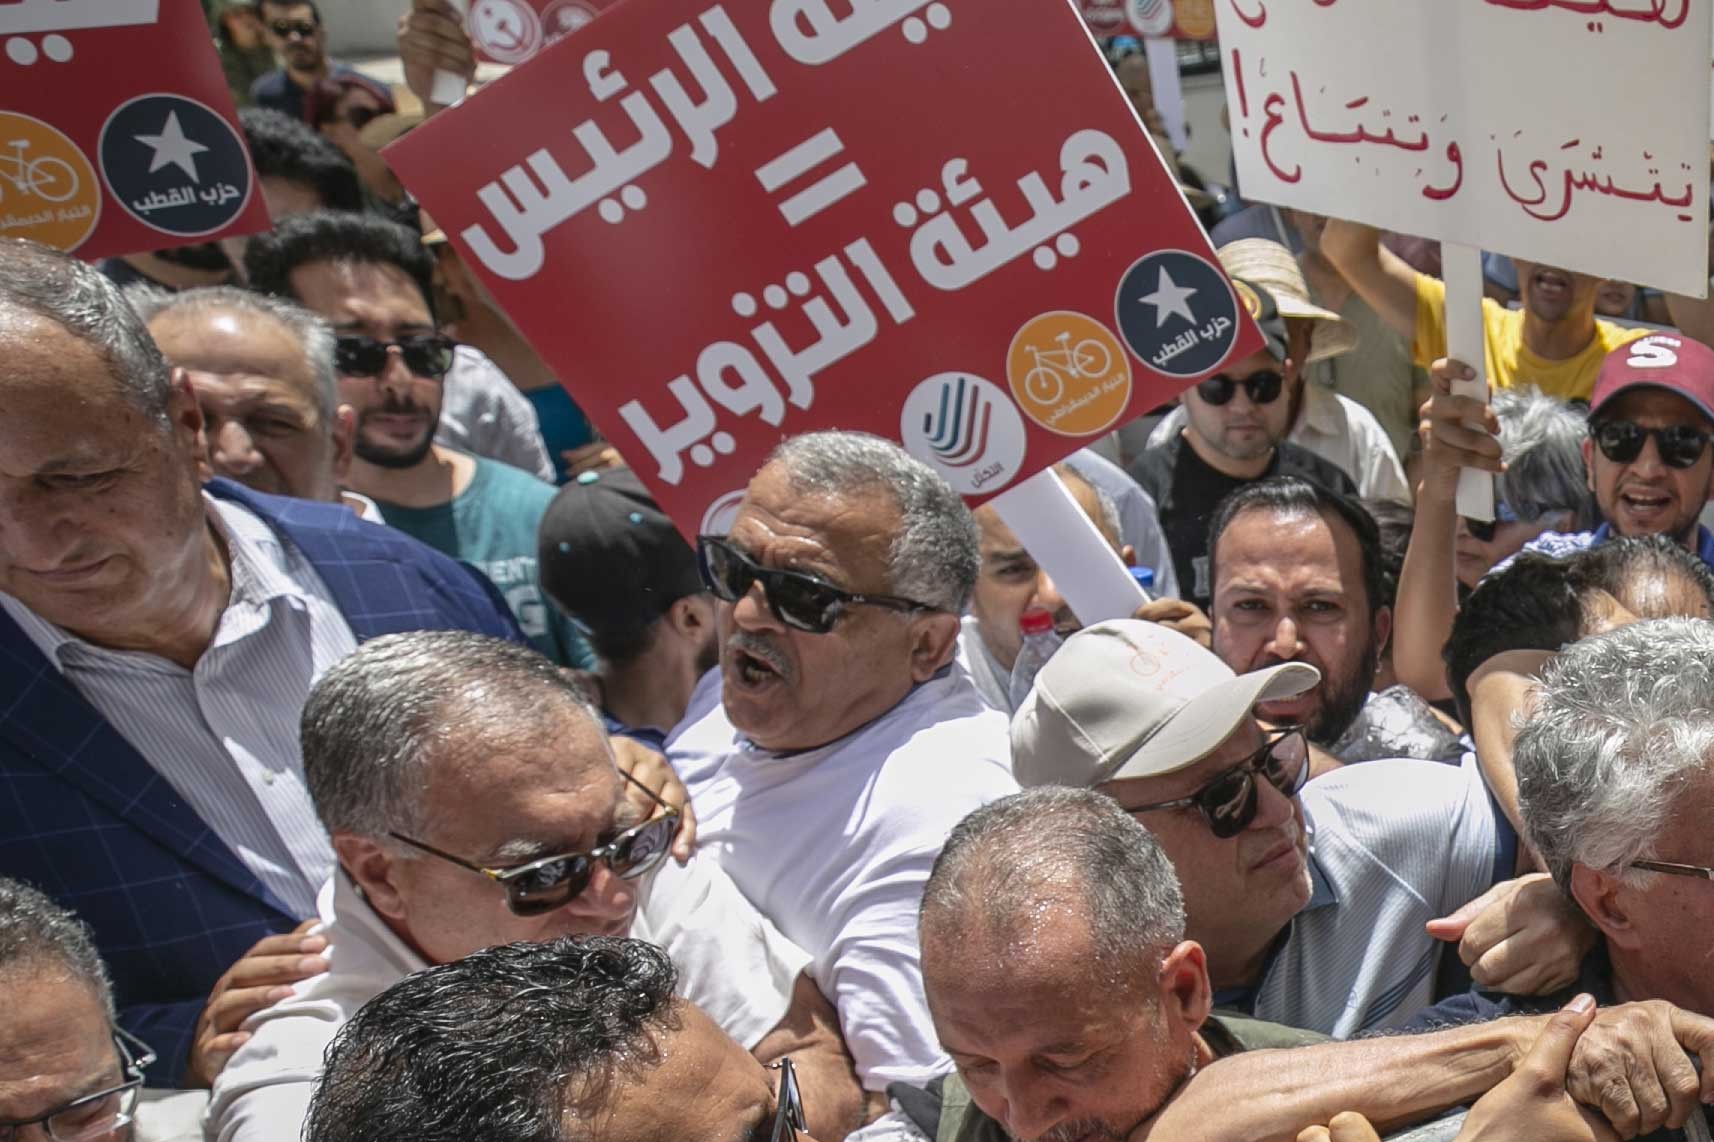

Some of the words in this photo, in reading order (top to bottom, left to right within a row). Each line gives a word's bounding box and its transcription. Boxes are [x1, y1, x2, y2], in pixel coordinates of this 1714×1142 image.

[460, 4, 778, 280] الرئيس
[133, 186, 196, 215] القطب
[199, 182, 241, 205] حزب
[892, 129, 1133, 291] هيئة
[1200, 313, 1232, 341] حزب
[617, 236, 916, 486] التزوير
[1152, 329, 1199, 367] القطب
[1627, 336, 1681, 368] S
